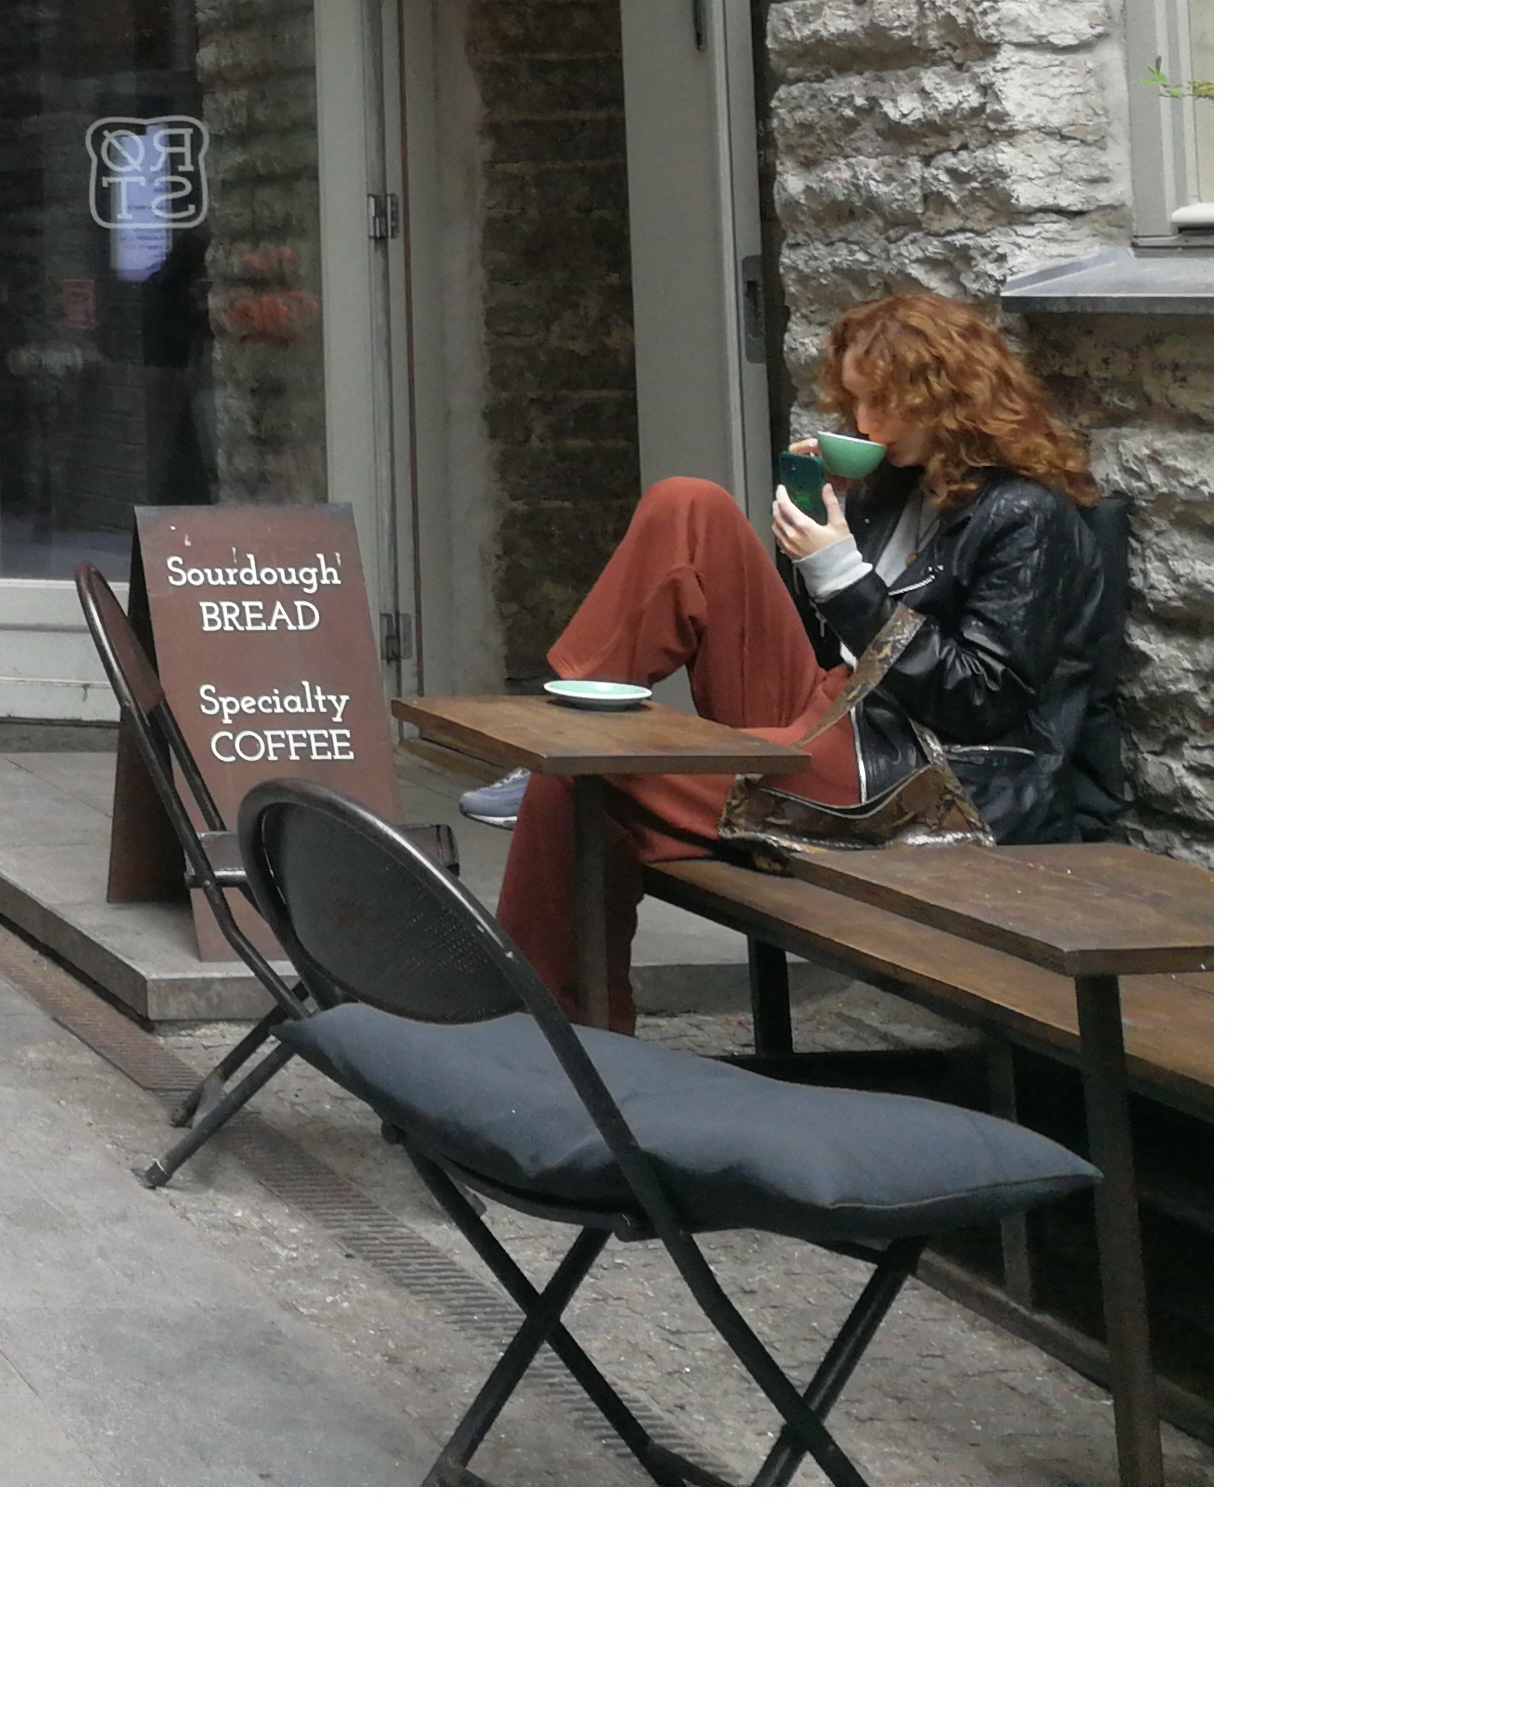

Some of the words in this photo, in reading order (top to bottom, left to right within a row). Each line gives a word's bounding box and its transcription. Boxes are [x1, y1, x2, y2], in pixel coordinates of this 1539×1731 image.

[167, 553, 342, 594] Sourdough
[199, 600, 321, 632] BREAD
[199, 680, 350, 724] Specialty
[210, 729, 355, 763] COFFEE
